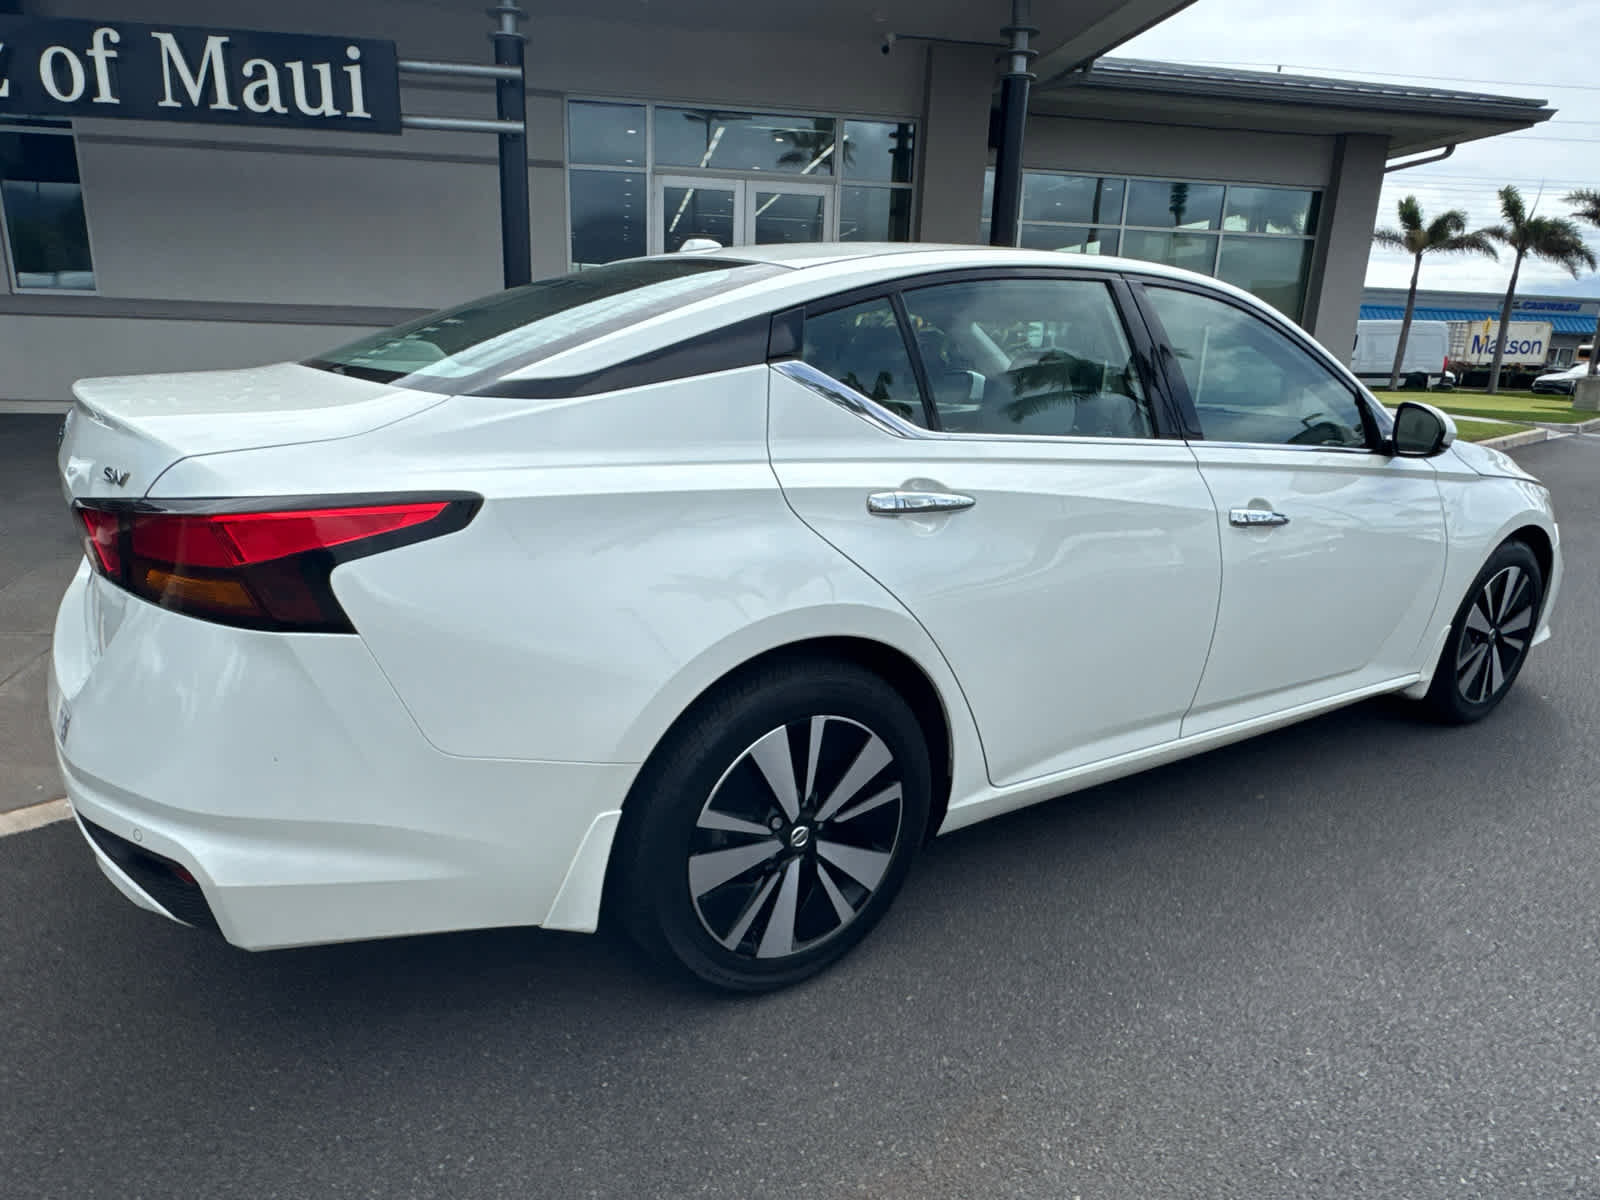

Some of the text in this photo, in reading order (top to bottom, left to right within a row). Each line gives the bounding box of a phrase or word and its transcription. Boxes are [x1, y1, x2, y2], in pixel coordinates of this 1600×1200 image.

[39, 27, 121, 104] of
[150, 31, 372, 119] Maui
[104, 466, 131, 488] SV
